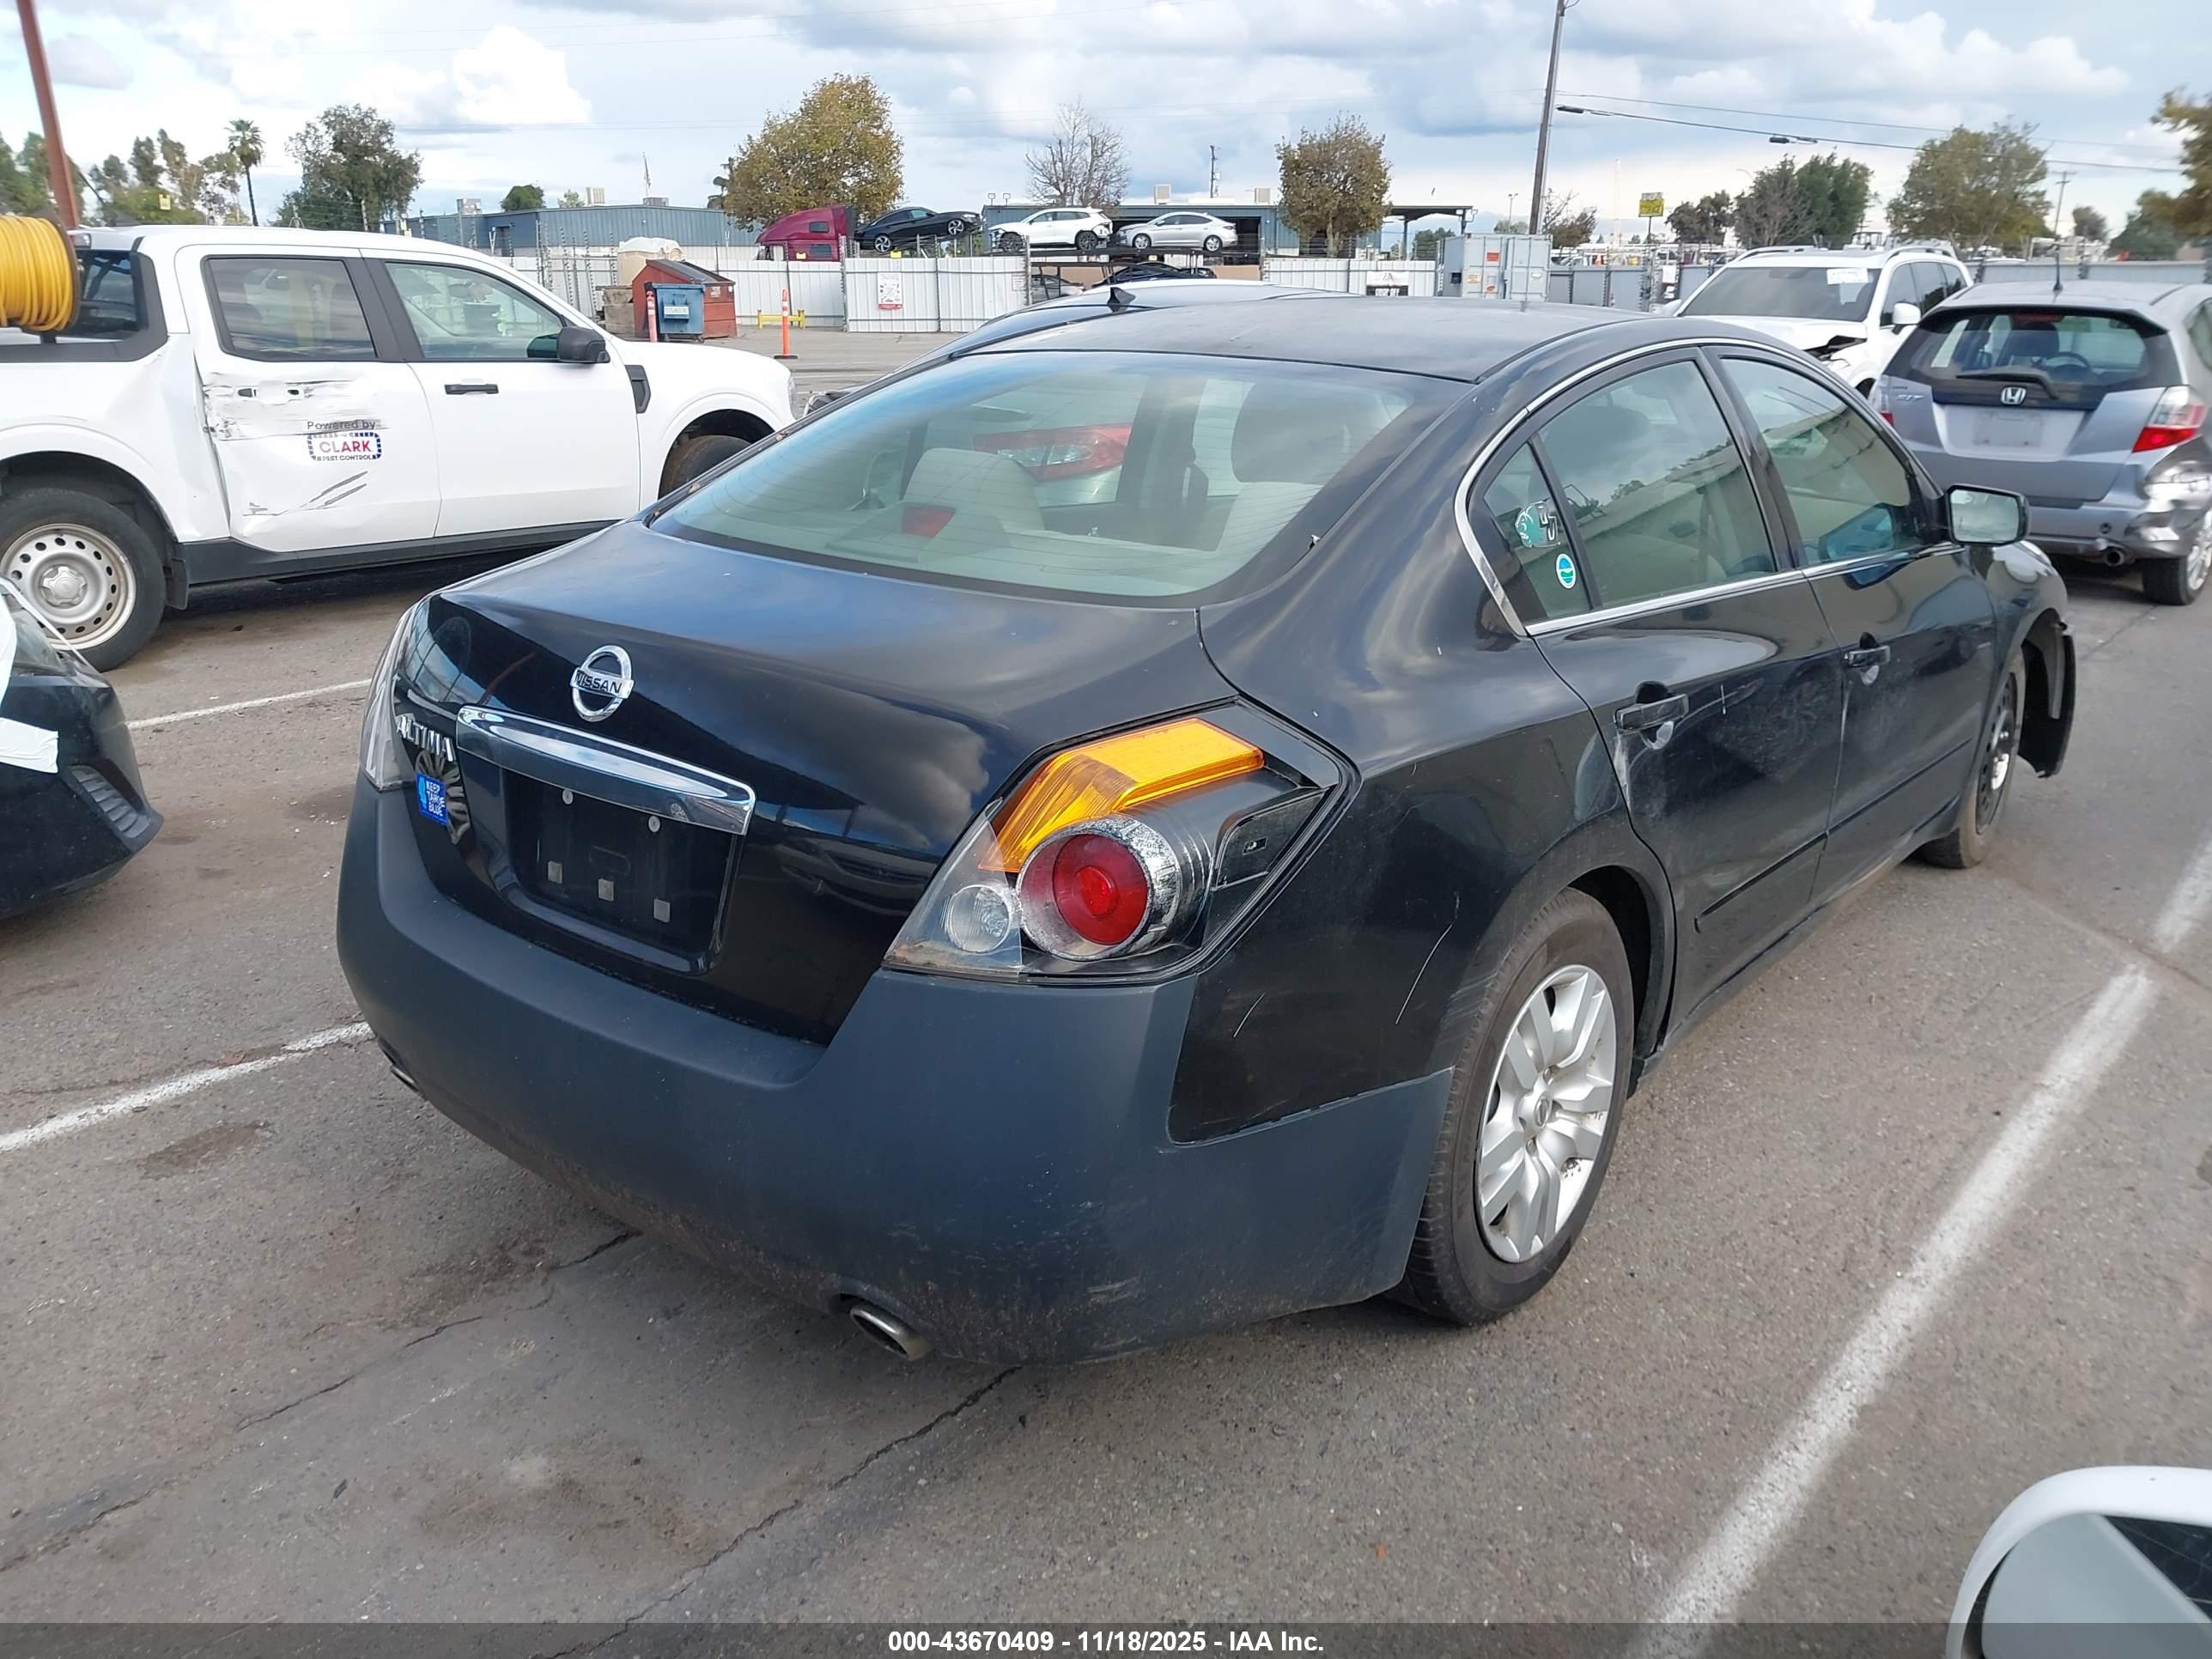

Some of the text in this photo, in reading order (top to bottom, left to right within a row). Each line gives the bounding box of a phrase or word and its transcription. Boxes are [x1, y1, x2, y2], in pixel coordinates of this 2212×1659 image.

[307, 419, 376, 430] Powered by
[319, 440, 372, 453] CLARK
[574, 670, 623, 694] NISSAN
[396, 714, 457, 763] ALTIMA
[426, 780, 441, 793] KEEP
